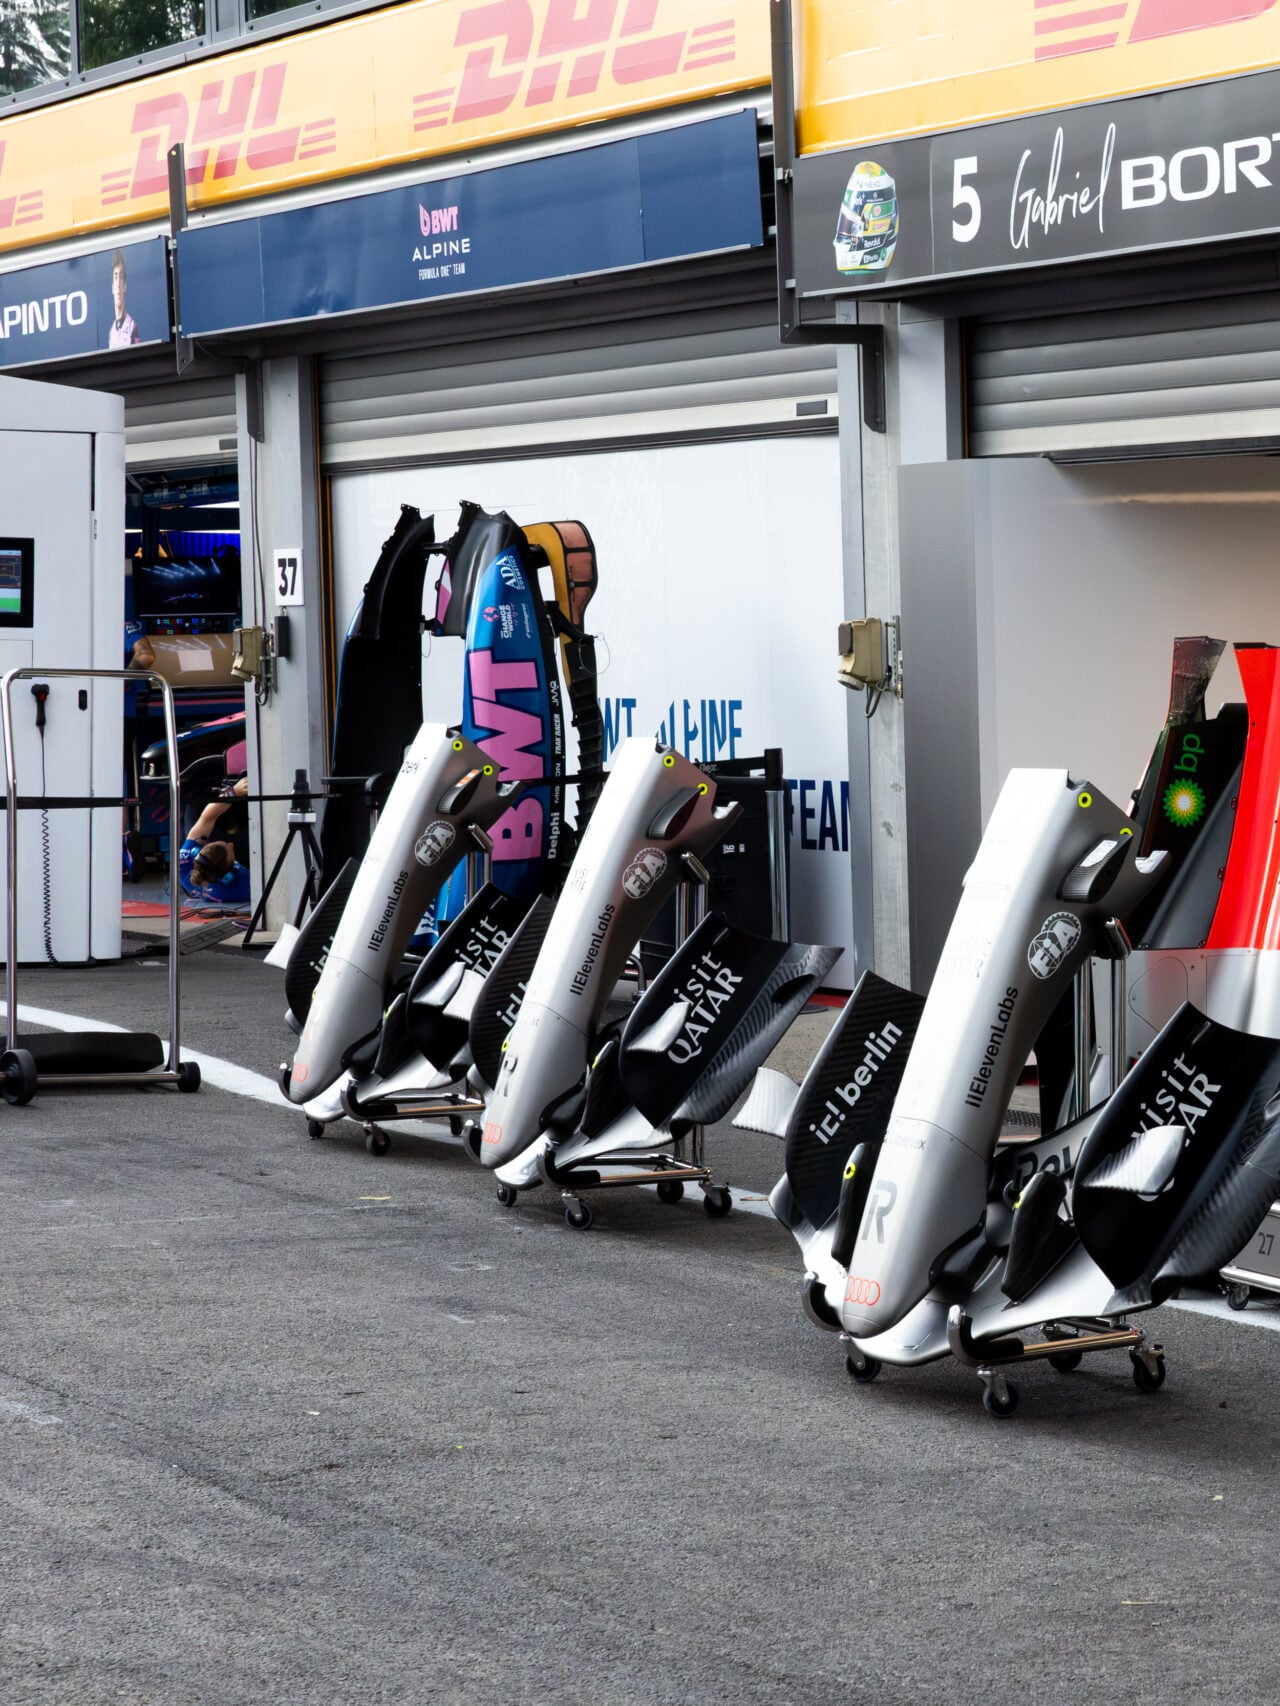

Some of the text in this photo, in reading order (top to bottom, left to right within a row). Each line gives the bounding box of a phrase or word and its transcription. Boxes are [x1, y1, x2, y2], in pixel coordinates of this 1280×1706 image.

[452, 0, 688, 124] DHL
[130, 61, 301, 199] DHL
[952, 157, 981, 243] 5
[1009, 123, 1116, 249] Gabriel
[431, 206, 458, 234] BWT
[412, 238, 470, 262] ALPINE
[419, 267, 439, 280] FORMULA
[453, 263, 466, 275] TEAM
[277, 558, 298, 596] 37
[496, 555, 520, 589] ADA
[599, 697, 636, 763] WT
[1174, 733, 1205, 774] bp
[468, 650, 544, 862] BWT
[416, 826, 454, 866] FIA
[548, 811, 560, 860] Delphi
[625, 852, 666, 897] FIA
[455, 916, 498, 965] isit
[472, 930, 512, 978] TAR
[1030, 920, 1080, 978] FIA
[673, 951, 721, 1006] isit
[668, 967, 743, 1064] QATAR
[809, 1021, 903, 1145] ic! berlin
[861, 1179, 898, 1246] R
[1258, 1231, 1274, 1256] 27
